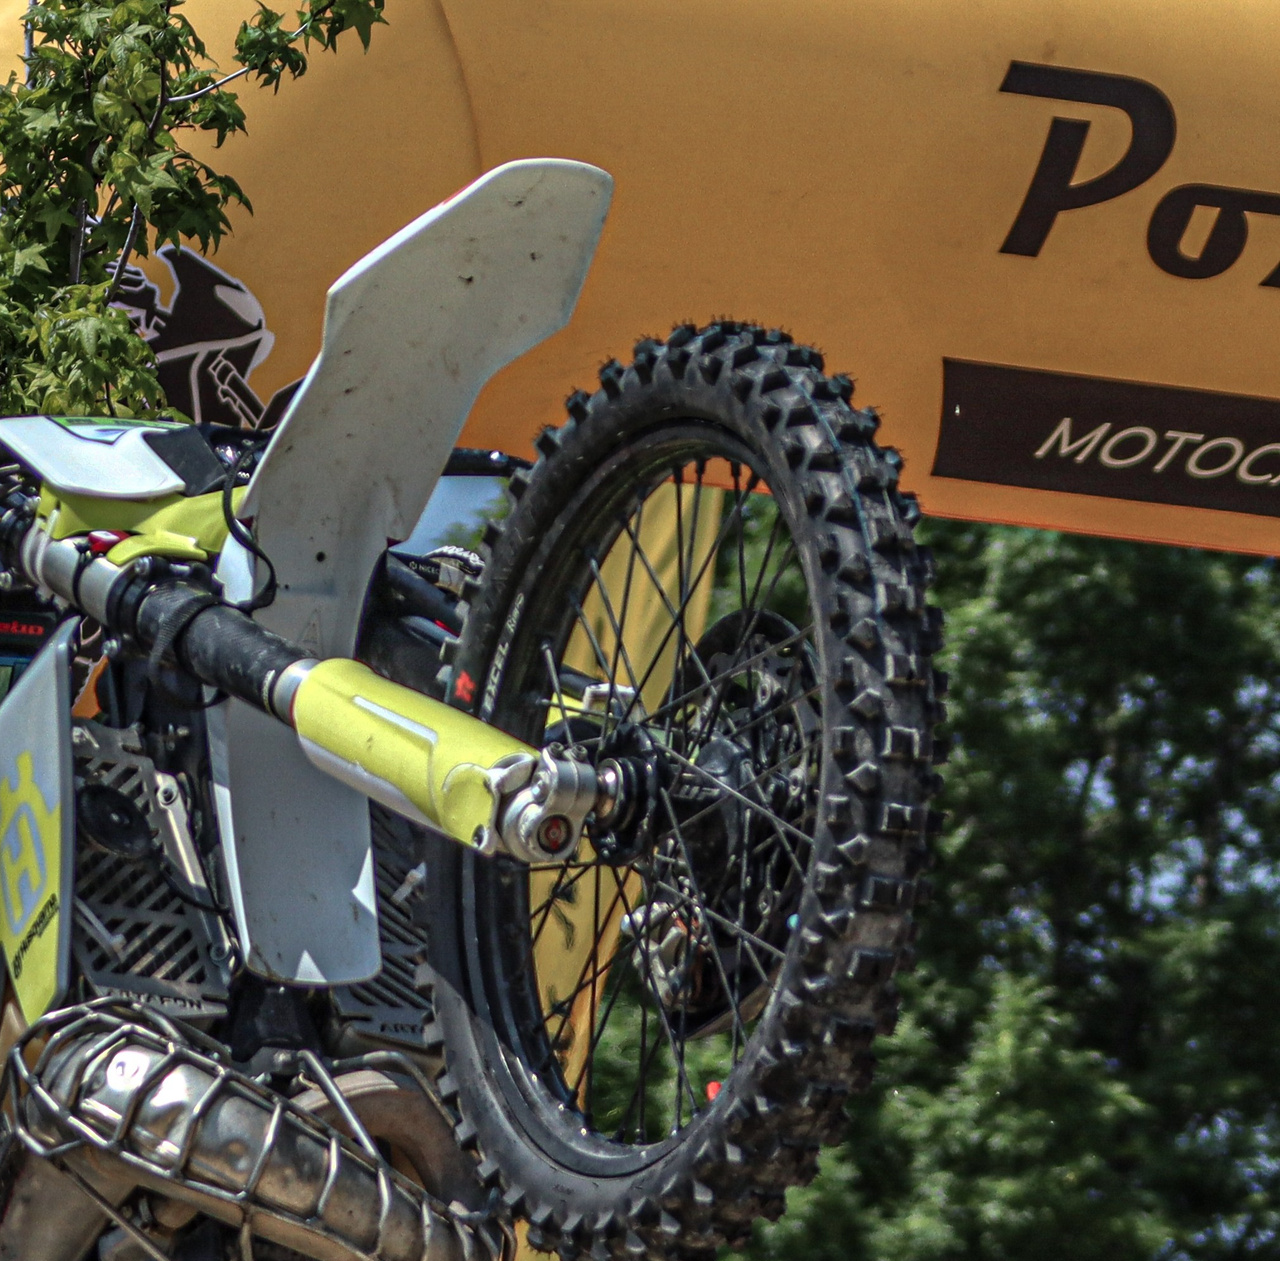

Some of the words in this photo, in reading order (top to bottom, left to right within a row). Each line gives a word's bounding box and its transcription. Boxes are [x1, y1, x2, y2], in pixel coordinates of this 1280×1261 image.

[999, 60, 1280, 289] Po
[1035, 417, 1280, 488] MOTOC
[481, 641, 510, 713] EXCEL
